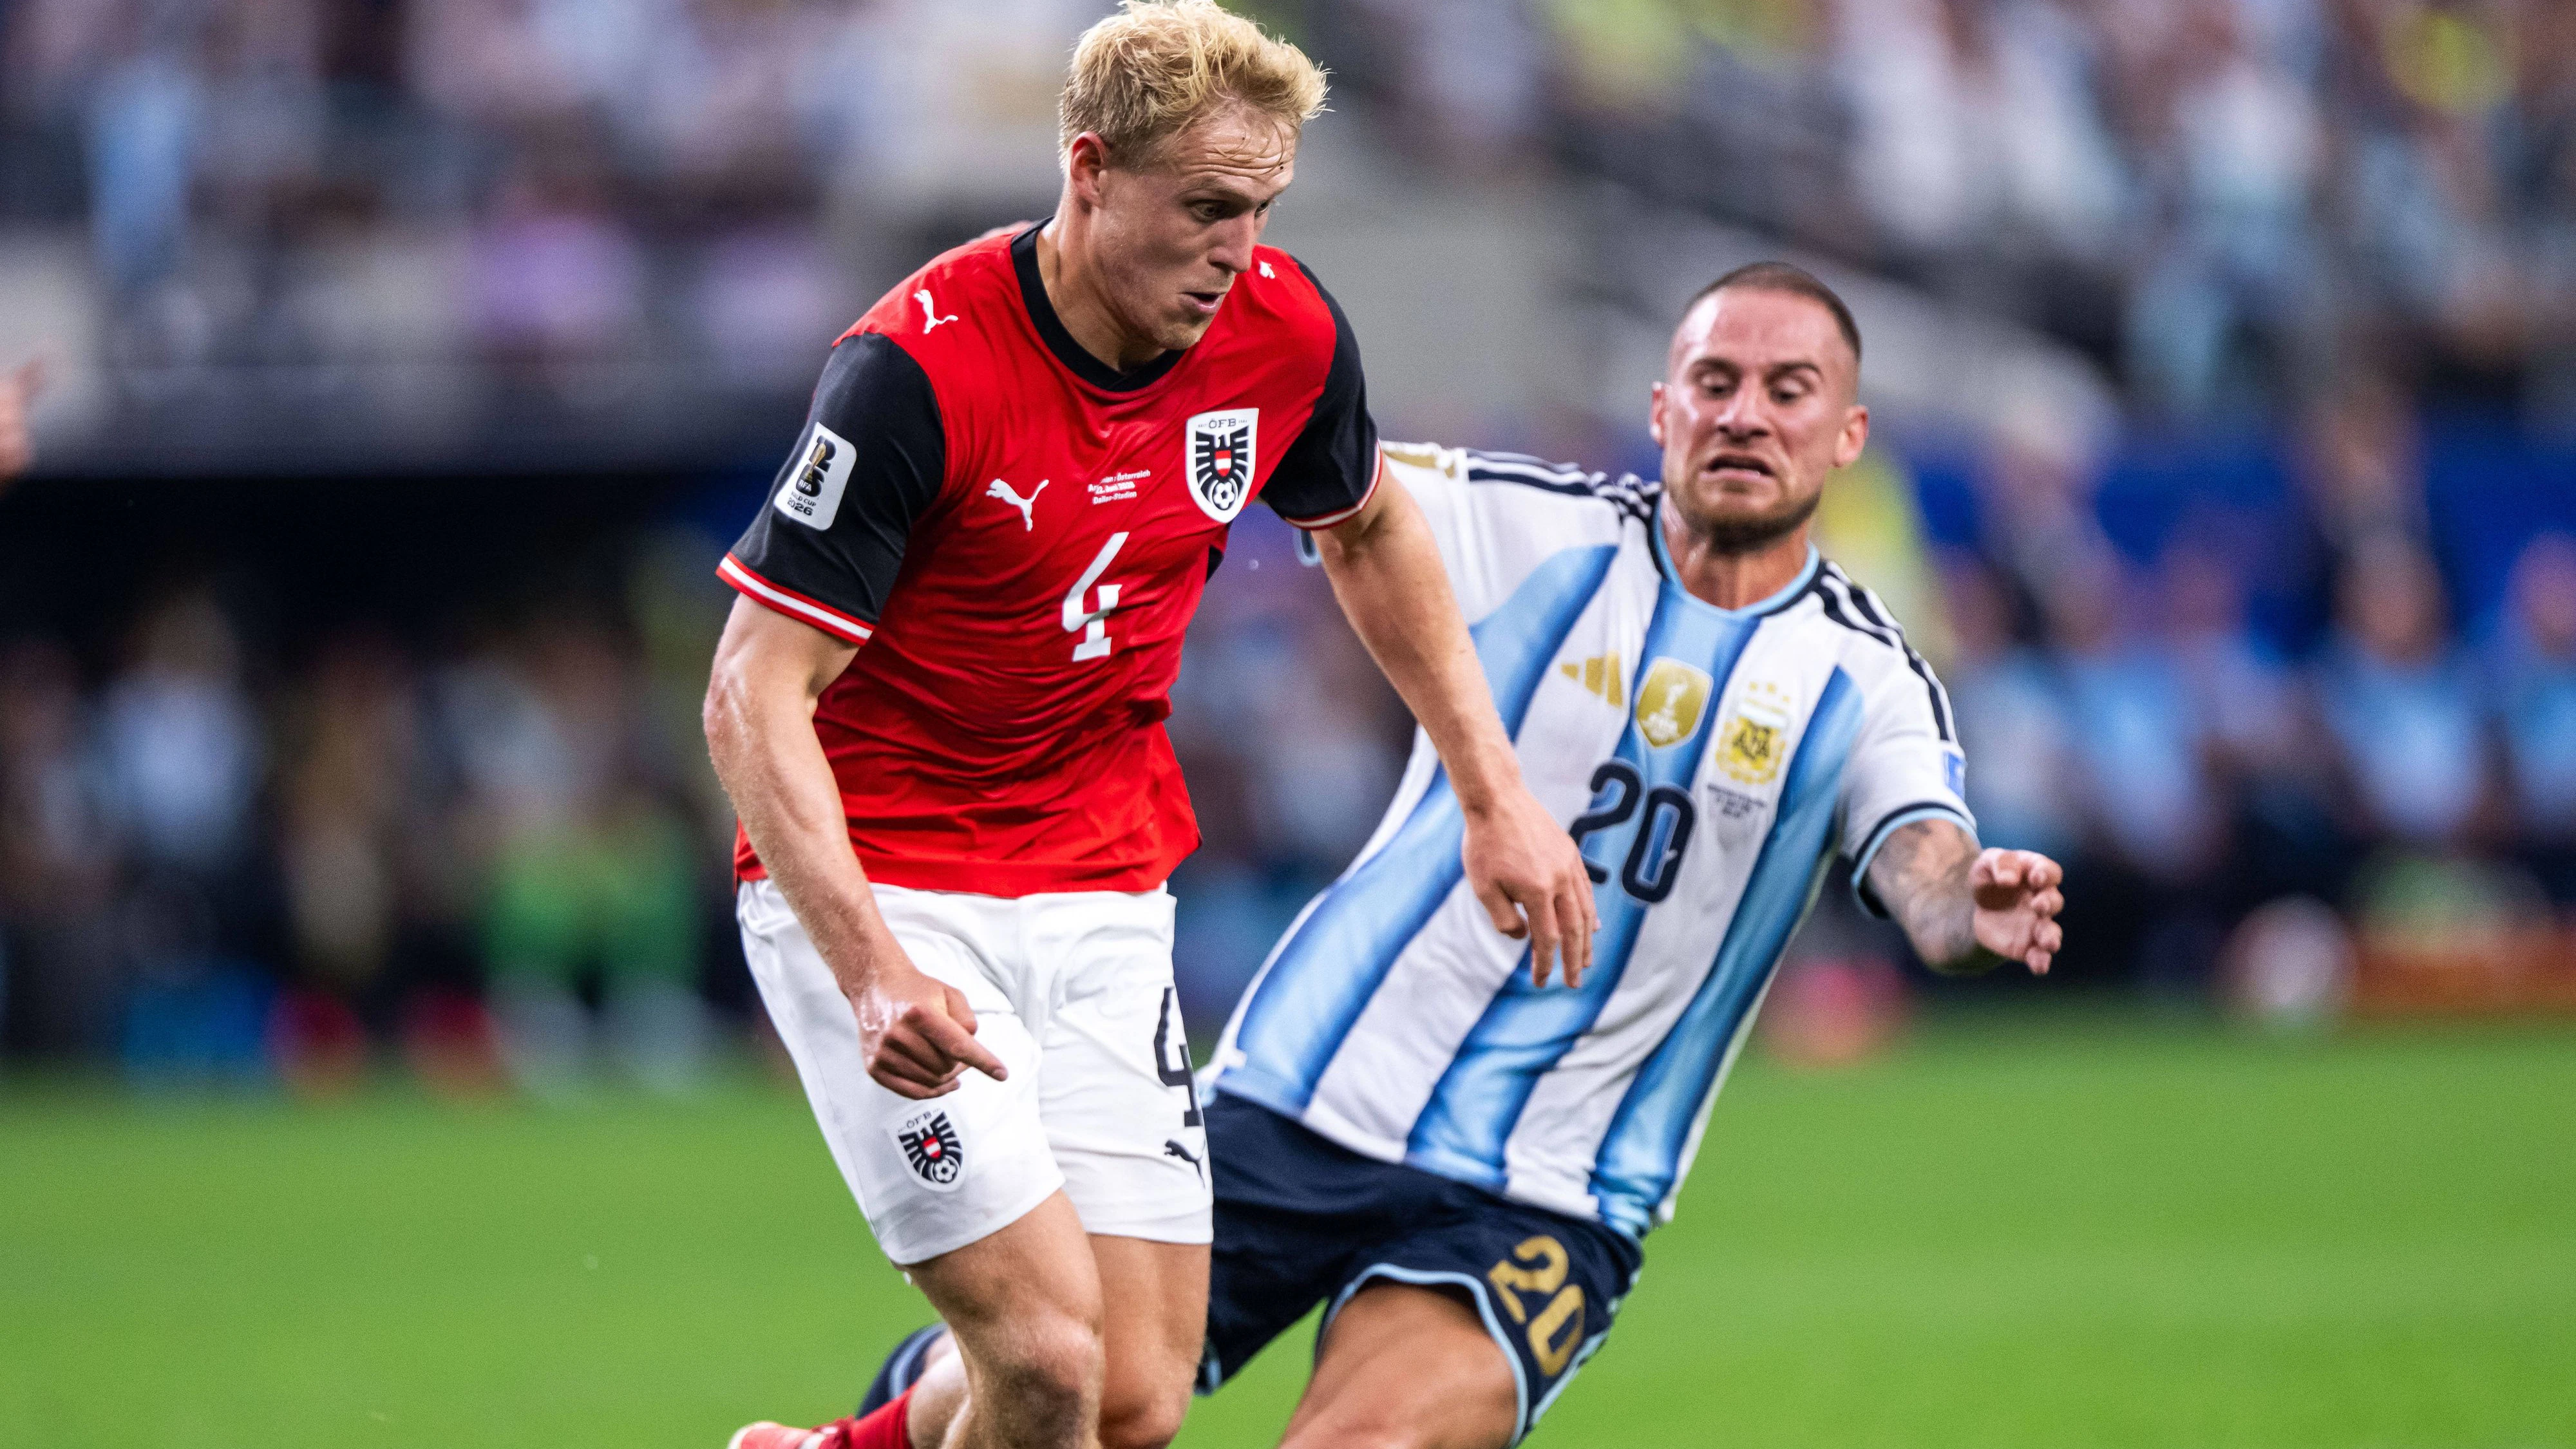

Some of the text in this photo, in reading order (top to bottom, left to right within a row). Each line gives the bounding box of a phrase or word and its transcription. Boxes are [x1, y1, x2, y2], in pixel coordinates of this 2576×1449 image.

[1209, 418, 1236, 428] ÖFB
[787, 497, 813, 516] 2026
[804, 498, 817, 506] CUP
[1117, 469, 1151, 481] Österreich
[1061, 531, 1130, 663] 4
[1569, 758, 1698, 904] 20
[1153, 987, 1204, 1127] 4
[1488, 1235, 1585, 1376] 20
